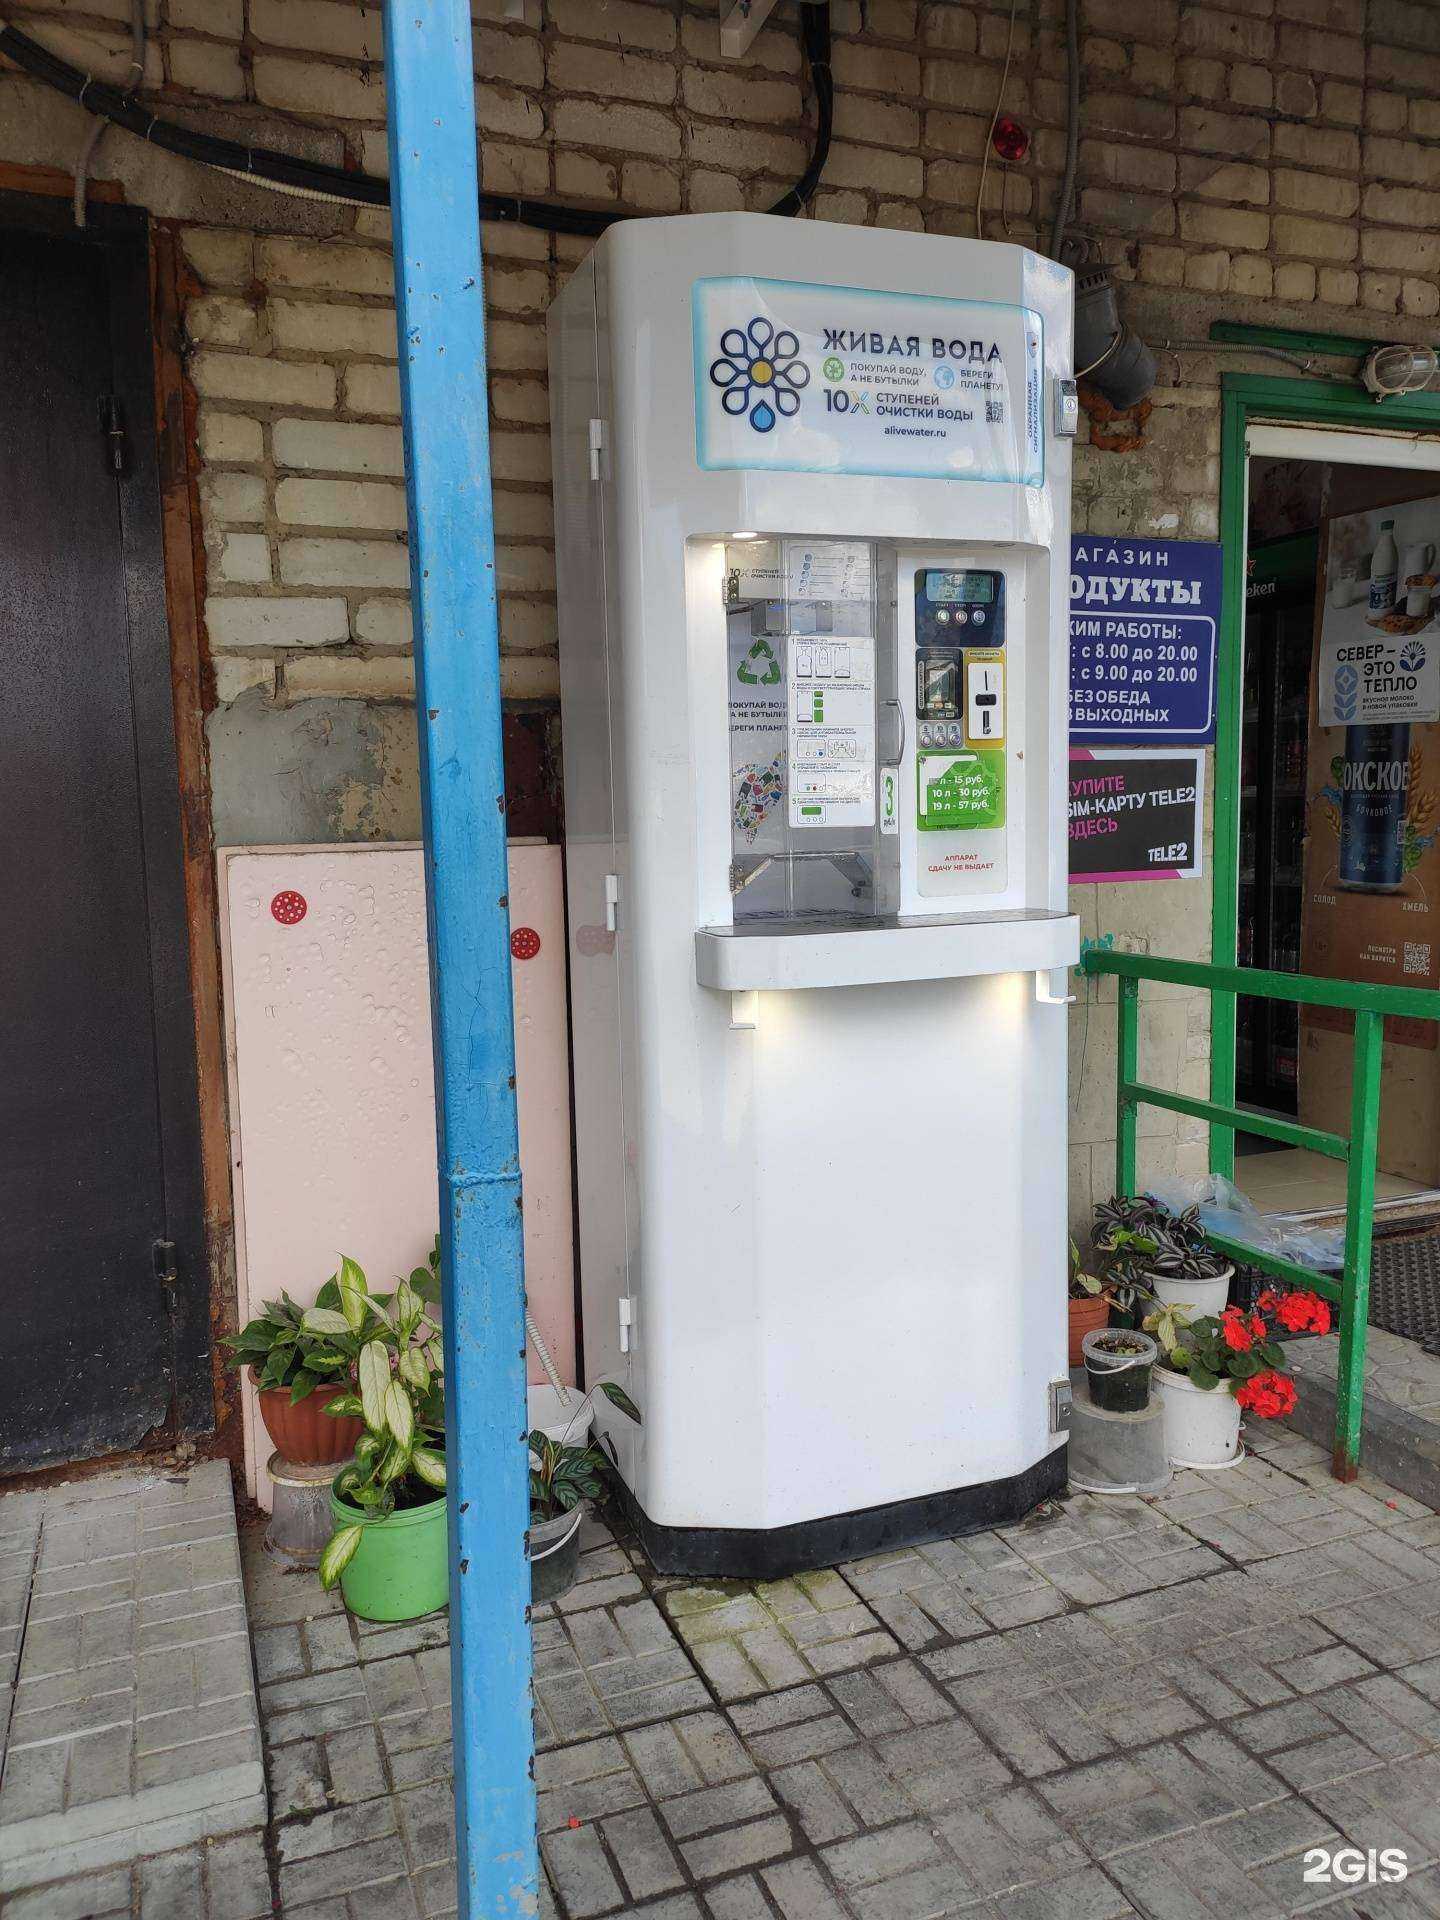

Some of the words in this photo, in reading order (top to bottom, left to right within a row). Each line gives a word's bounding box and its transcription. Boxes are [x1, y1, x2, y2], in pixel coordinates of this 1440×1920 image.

[822, 329, 920, 357] ЖИВАЯ
[932, 338, 1002, 364] ВОДА
[850, 361, 896, 374] ПОКУПАЙ
[899, 366, 927, 377] ВОДУ,
[960, 369, 994, 379] БЕРЕГИ
[860, 375, 873, 383] НЕ
[875, 376, 920, 386] БУТЫЛКИ
[876, 392, 939, 406] СТУПЕНЕЙ
[876, 405, 933, 419] ОЧИСТКИ
[937, 409, 973, 422] ВОДЫ
[884, 425, 947, 438] alivewater.ru
[1074, 547, 1169, 567] АГАЗИН
[1070, 574, 1202, 605] ОДУКТЫ
[1247, 582, 1275, 597] eken
[1105, 621, 1182, 640] РАБОТЫ:
[1081, 646, 1091, 658] с
[1095, 643, 1128, 659] 8.00
[1132, 648, 1153, 662] до
[1157, 645, 1198, 661] 20.00
[1337, 644, 1384, 662] СЕВЕР
[1081, 667, 1090, 679] с
[1095, 665, 1128, 680] 9.00
[1131, 669, 1153, 683] до
[1157, 667, 1198, 682] 20.00
[1364, 661, 1395, 676] ЭТО
[791, 682, 796, 690] 2
[1364, 676, 1418, 693] ТЕПЛО
[1096, 690, 1151, 706] ОБЕДА
[1075, 708, 1170, 723] ВЫХОДНЫХ
[791, 727, 796, 735] 3
[965, 775, 984, 785] руб.
[1343, 761, 1409, 791] ОКСКОЕ
[932, 789, 942, 797] 10
[959, 788, 970, 796] 30
[972, 787, 990, 798] руб.
[1069, 775, 1125, 797] УПИТЕ
[886, 776, 893, 816] 3
[1149, 786, 1196, 807] TELE2
[933, 802, 942, 810] 19
[958, 801, 968, 809] 57
[971, 801, 990, 810] руб.
[944, 854, 978, 862] АППАРАТ
[1148, 842, 1188, 862] TELE2
[965, 862, 994, 870] ВЫДАЕТ
[1313, 894, 1336, 905] СОЛОД
[1402, 902, 1429, 912] ХМЕЛЬ
